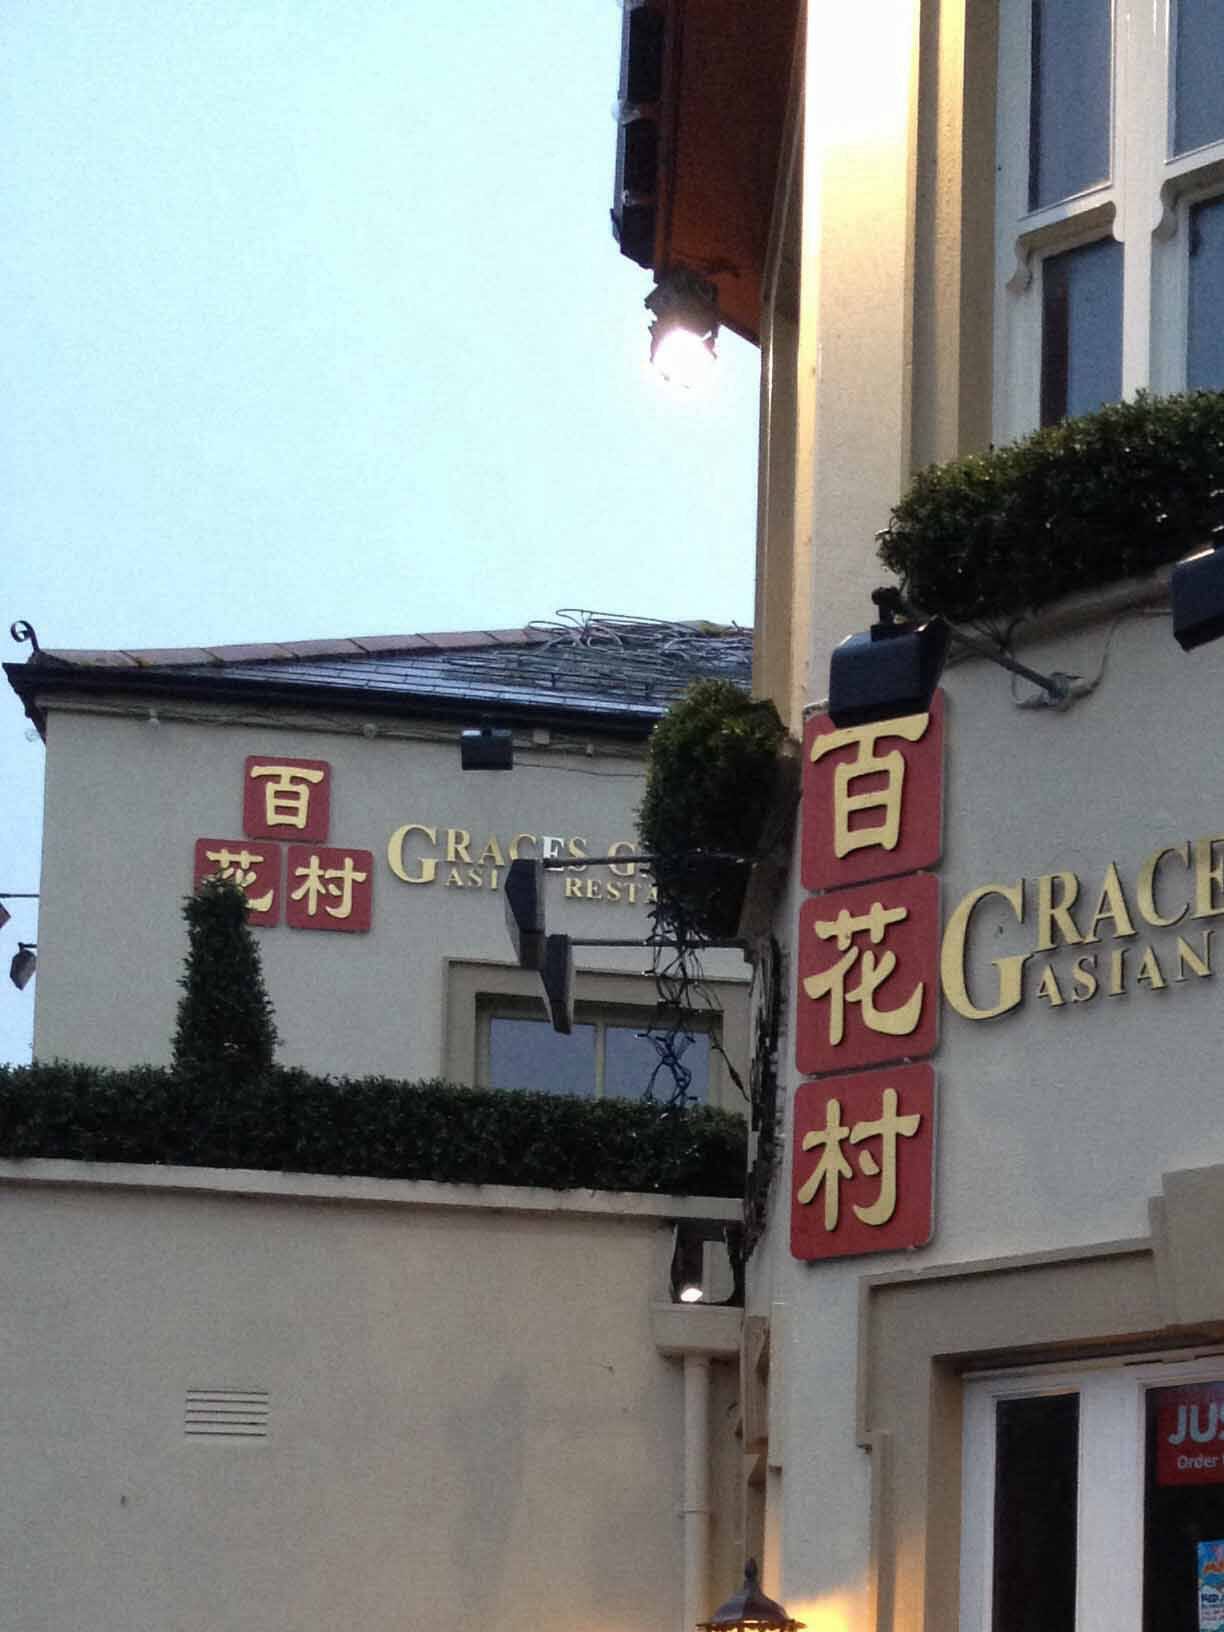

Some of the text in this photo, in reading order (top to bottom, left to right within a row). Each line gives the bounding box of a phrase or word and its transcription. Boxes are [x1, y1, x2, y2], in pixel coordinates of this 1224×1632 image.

[387, 823, 588, 885] GRACES
[445, 867, 499, 890] ASI
[1033, 930, 1213, 1009] ASIAN
[1176, 1454, 1218, 1470] Order
